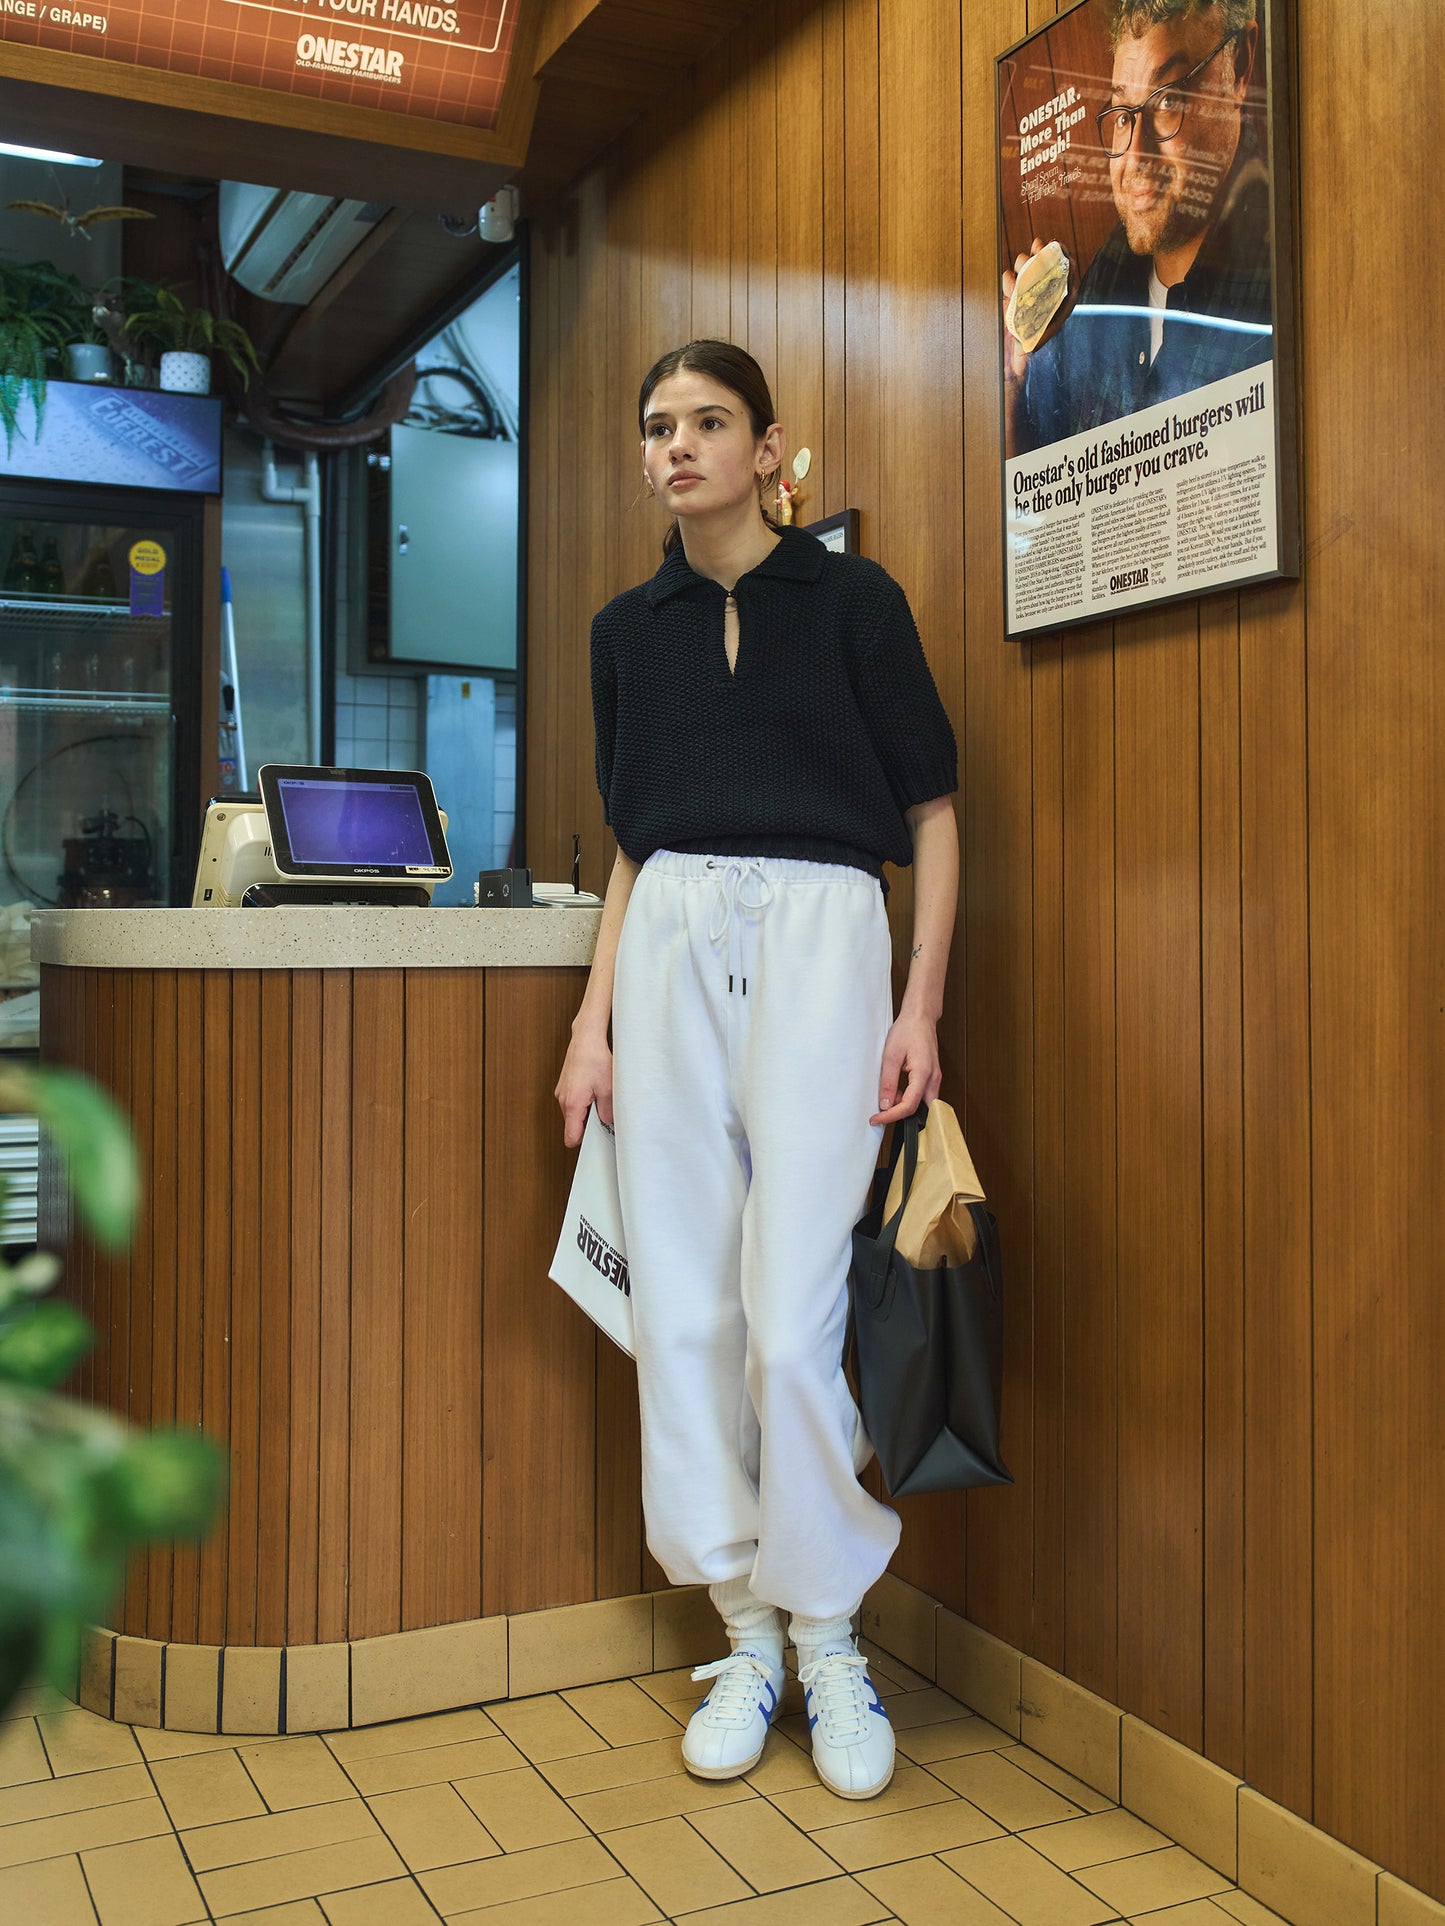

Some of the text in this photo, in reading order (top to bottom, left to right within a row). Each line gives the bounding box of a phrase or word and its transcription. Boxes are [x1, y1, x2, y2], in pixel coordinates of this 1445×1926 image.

[0, 0, 107, 33] NGE / GRAPE)
[381, 0, 461, 34] HANDS.
[296, 59, 401, 84] OLD-FASHIONED HAMBURGERS
[297, 34, 404, 77] ONESTAR
[1020, 87, 1081, 134] ONESTAR.
[1021, 106, 1086, 156] More Than
[1021, 131, 1071, 175] Enough!
[1013, 381, 1265, 494] Onestar's old fashioned burgers will
[1014, 440, 1208, 520] be the only burger you crave.
[1109, 567, 1149, 591] ONESTAR
[577, 1220, 631, 1297] NESTAR
